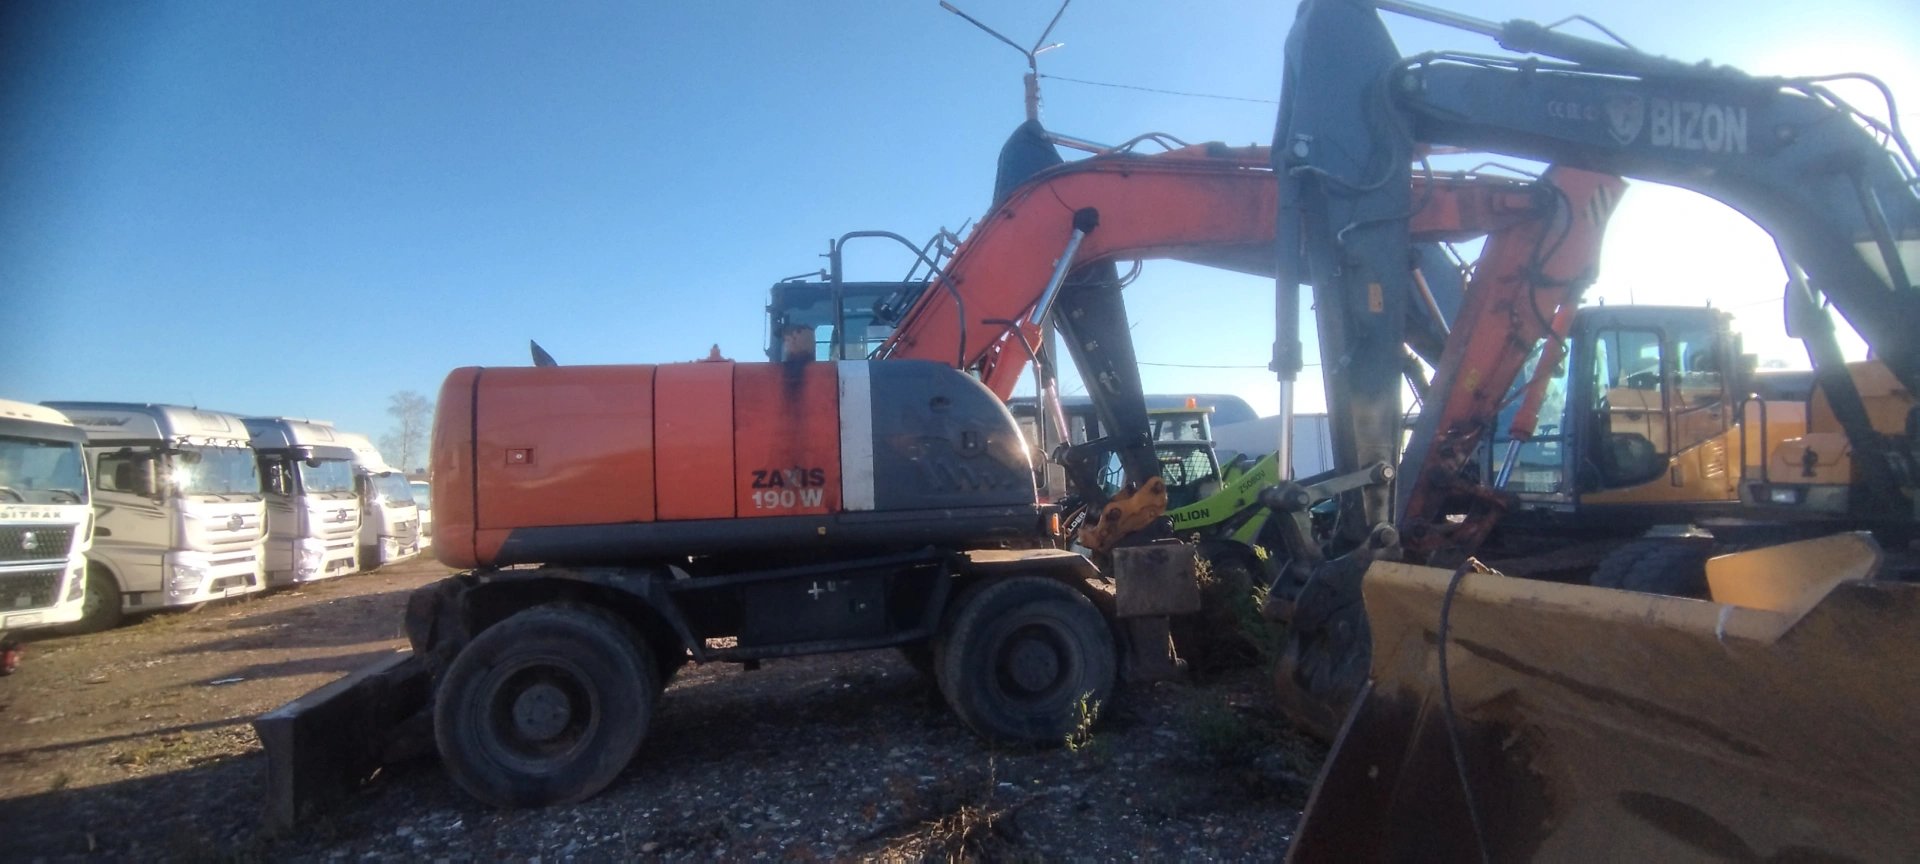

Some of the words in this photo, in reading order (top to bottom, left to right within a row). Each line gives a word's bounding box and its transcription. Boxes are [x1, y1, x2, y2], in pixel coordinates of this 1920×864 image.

[1651, 98, 1748, 152] BIZON
[752, 490, 796, 508] 190
[800, 489, 823, 507] W
[0, 511, 61, 519] SITRAK
